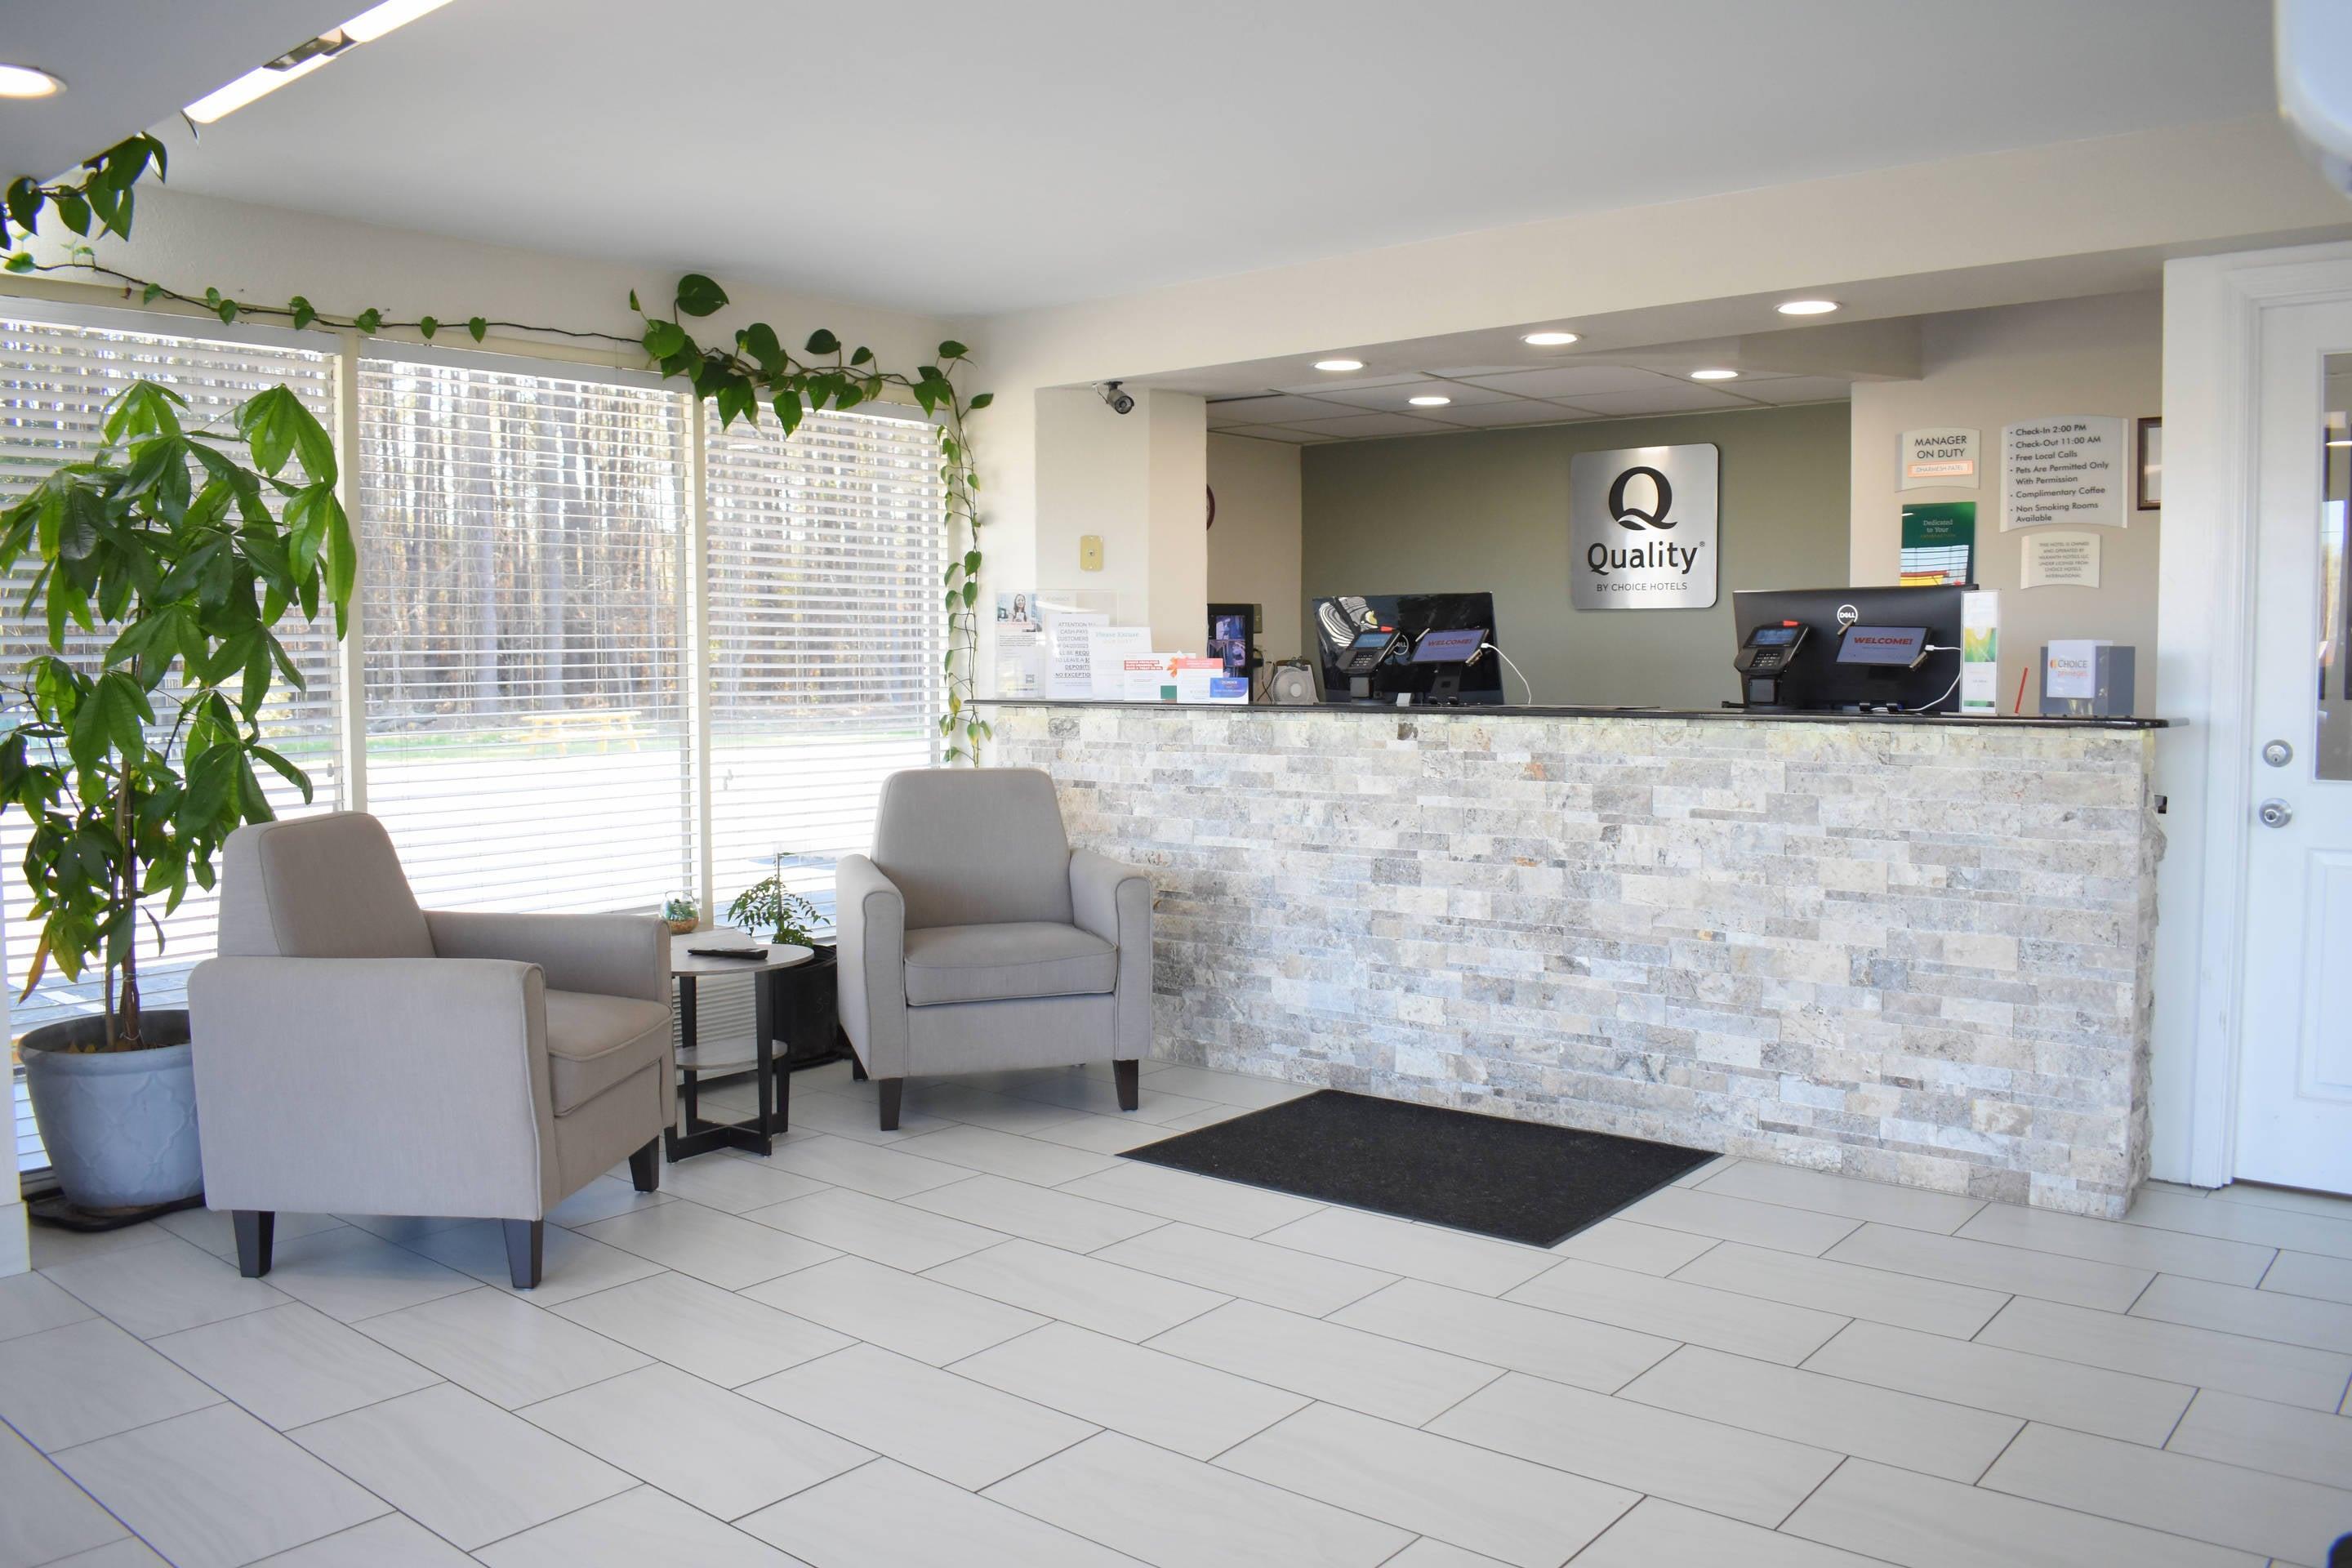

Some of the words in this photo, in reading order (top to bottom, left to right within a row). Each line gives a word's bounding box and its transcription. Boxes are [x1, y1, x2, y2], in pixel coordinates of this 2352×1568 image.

[2016, 427, 2050, 436] Check-In
[1915, 436, 1967, 446] MANAGER
[2016, 439, 2058, 449] Check-Out
[2062, 437, 2085, 445] 11:00
[1917, 450, 1934, 458] ON
[1938, 448, 1965, 458] DUTY
[2050, 463, 2087, 471] Permitted
[2090, 461, 2109, 470] Only
[2036, 475, 2078, 484] Permission
[2016, 489, 2076, 499] Complimentary
[2079, 486, 2105, 494] Coffee
[1609, 466, 1678, 530] Q
[2036, 503, 2069, 512] Smoking
[2016, 514, 2052, 522] Available
[1597, 583, 1608, 592] BY
[1611, 583, 1647, 591] CHOICE
[1650, 582, 1687, 590] HOTELS
[1428, 638, 1473, 647] WELCOME!
[1854, 637, 1914, 645] WELCOME!
[2058, 659, 2087, 668] CHOICE
